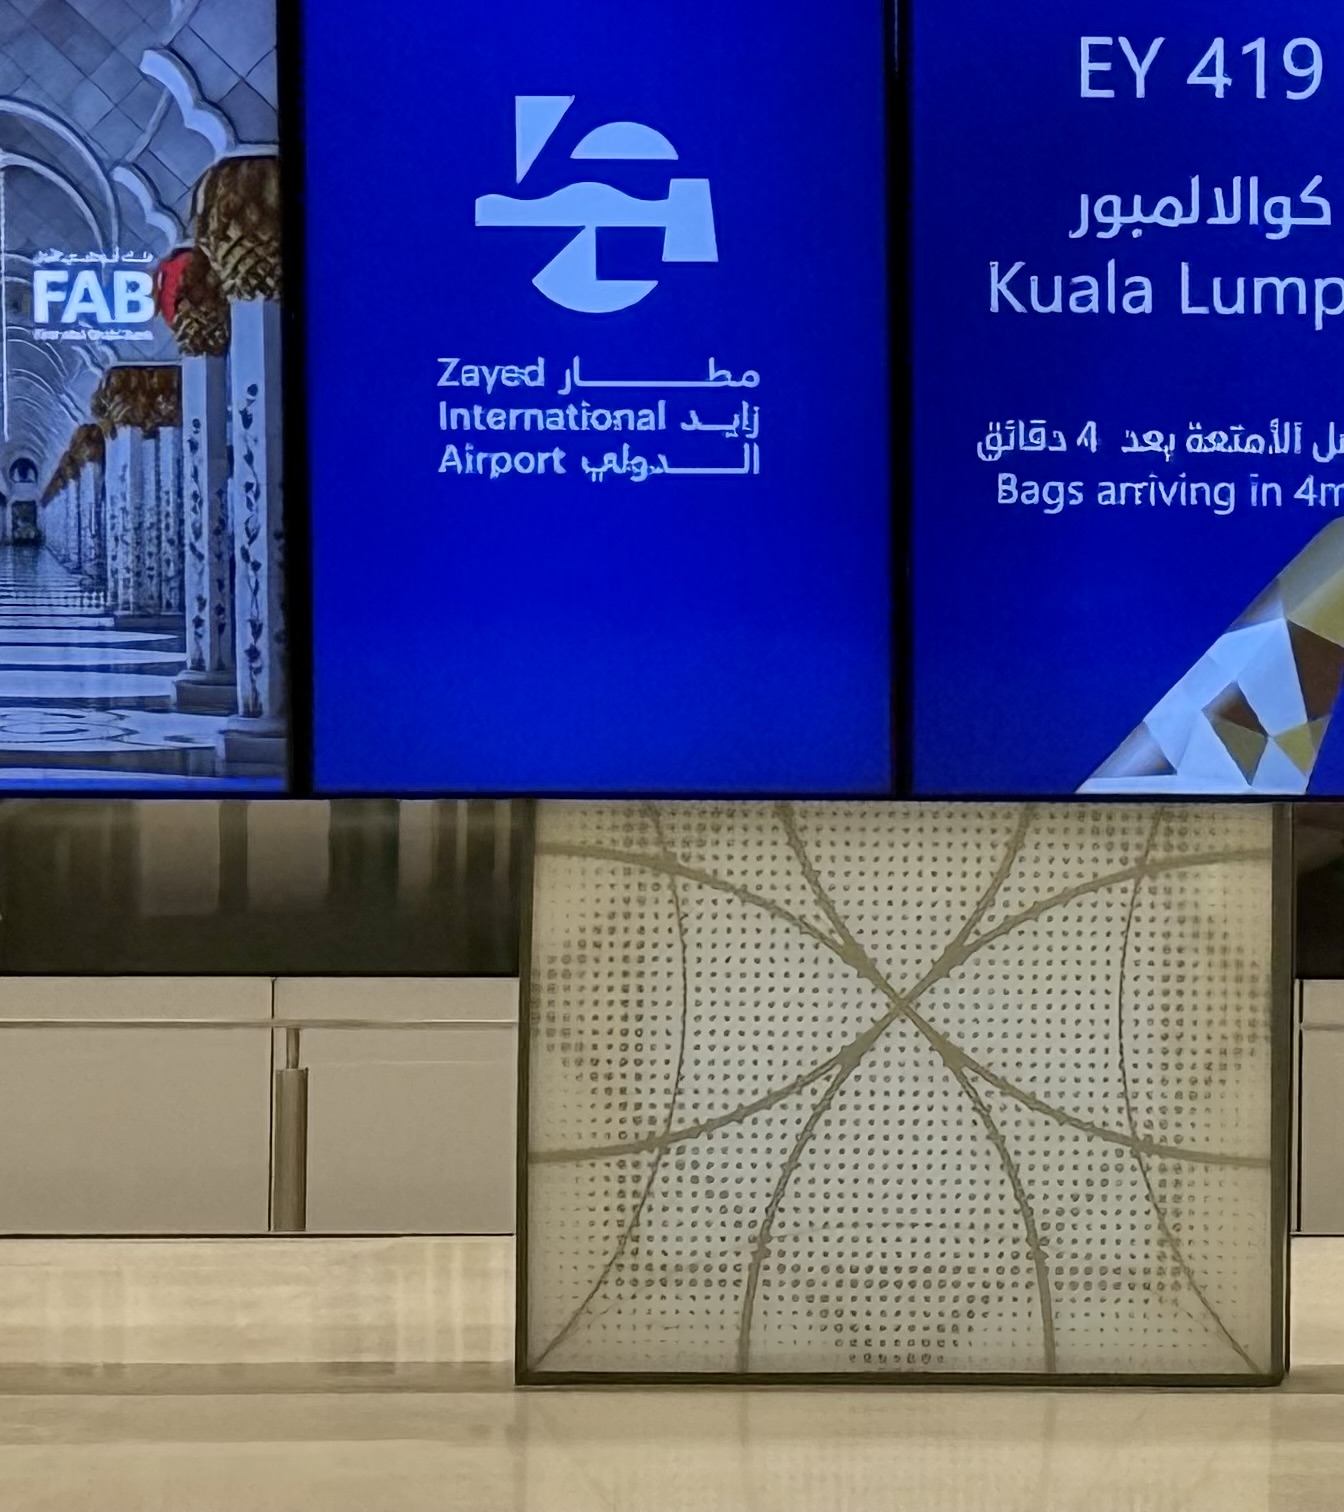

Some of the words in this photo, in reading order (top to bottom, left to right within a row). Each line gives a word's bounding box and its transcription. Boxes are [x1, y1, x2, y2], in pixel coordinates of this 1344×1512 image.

[1079, 35, 1166, 100] EY
[1186, 35, 1324, 101] 419
[33, 269, 156, 324] FAB
[988, 259, 1154, 316] Kuala
[436, 355, 546, 395] Zayed
[556, 355, 761, 396] مطار
[438, 399, 667, 431] International
[437, 442, 567, 480] Airport
[1121, 429, 1177, 463] بعد
[996, 472, 1085, 514] Bags
[1096, 472, 1237, 515] arriving
[1249, 472, 1283, 507] in
